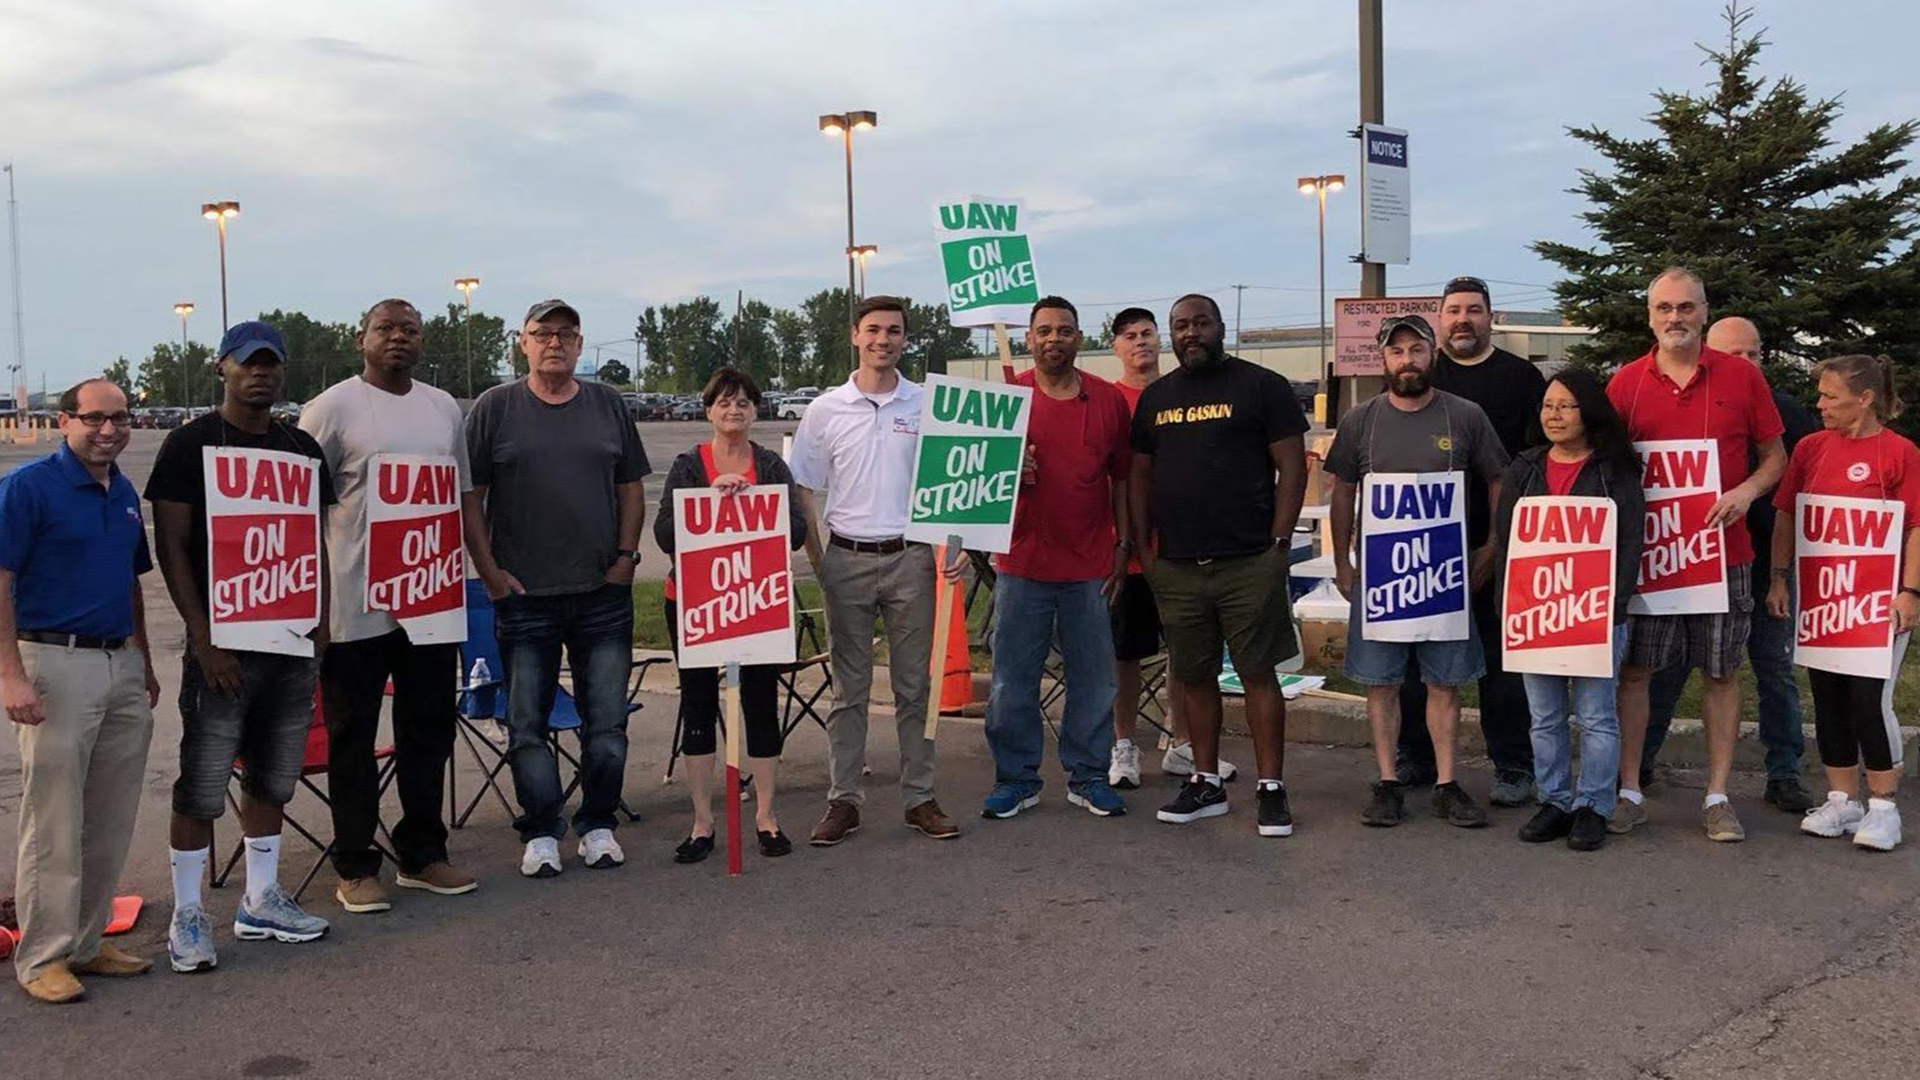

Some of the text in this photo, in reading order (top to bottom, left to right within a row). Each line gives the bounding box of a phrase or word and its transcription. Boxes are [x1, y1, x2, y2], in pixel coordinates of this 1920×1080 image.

[1370, 140, 1403, 159] NOTICE
[939, 203, 1018, 232] UAW
[968, 239, 1003, 271] ON
[950, 261, 1035, 309] STRIKE
[1343, 301, 1438, 315] RESTRICTED PARKING
[933, 384, 1024, 431] UAW
[1155, 403, 1233, 426] KING GASKIN
[946, 440, 988, 477] ON
[1636, 450, 1709, 489] AW
[216, 456, 312, 507] UAW
[378, 463, 456, 505] UAW
[913, 470, 1016, 519] STRIKE
[1371, 483, 1455, 520] UAW
[684, 493, 780, 535] UAW
[1517, 505, 1608, 544] UAW
[1803, 504, 1894, 548] UAW
[244, 518, 286, 565] ON
[402, 519, 441, 566] ON
[1391, 532, 1430, 574] ON
[1636, 527, 1720, 586] TRIKE
[214, 554, 317, 619] STRIKE
[369, 547, 464, 612] STRIKE
[711, 545, 752, 592] ON
[1367, 556, 1463, 619] STRIKE
[1533, 556, 1574, 600] ON
[1819, 560, 1857, 600] ON
[684, 571, 789, 643] STRIKE
[1507, 586, 1610, 647] STRIKE
[1798, 590, 1892, 642] STRIKE
